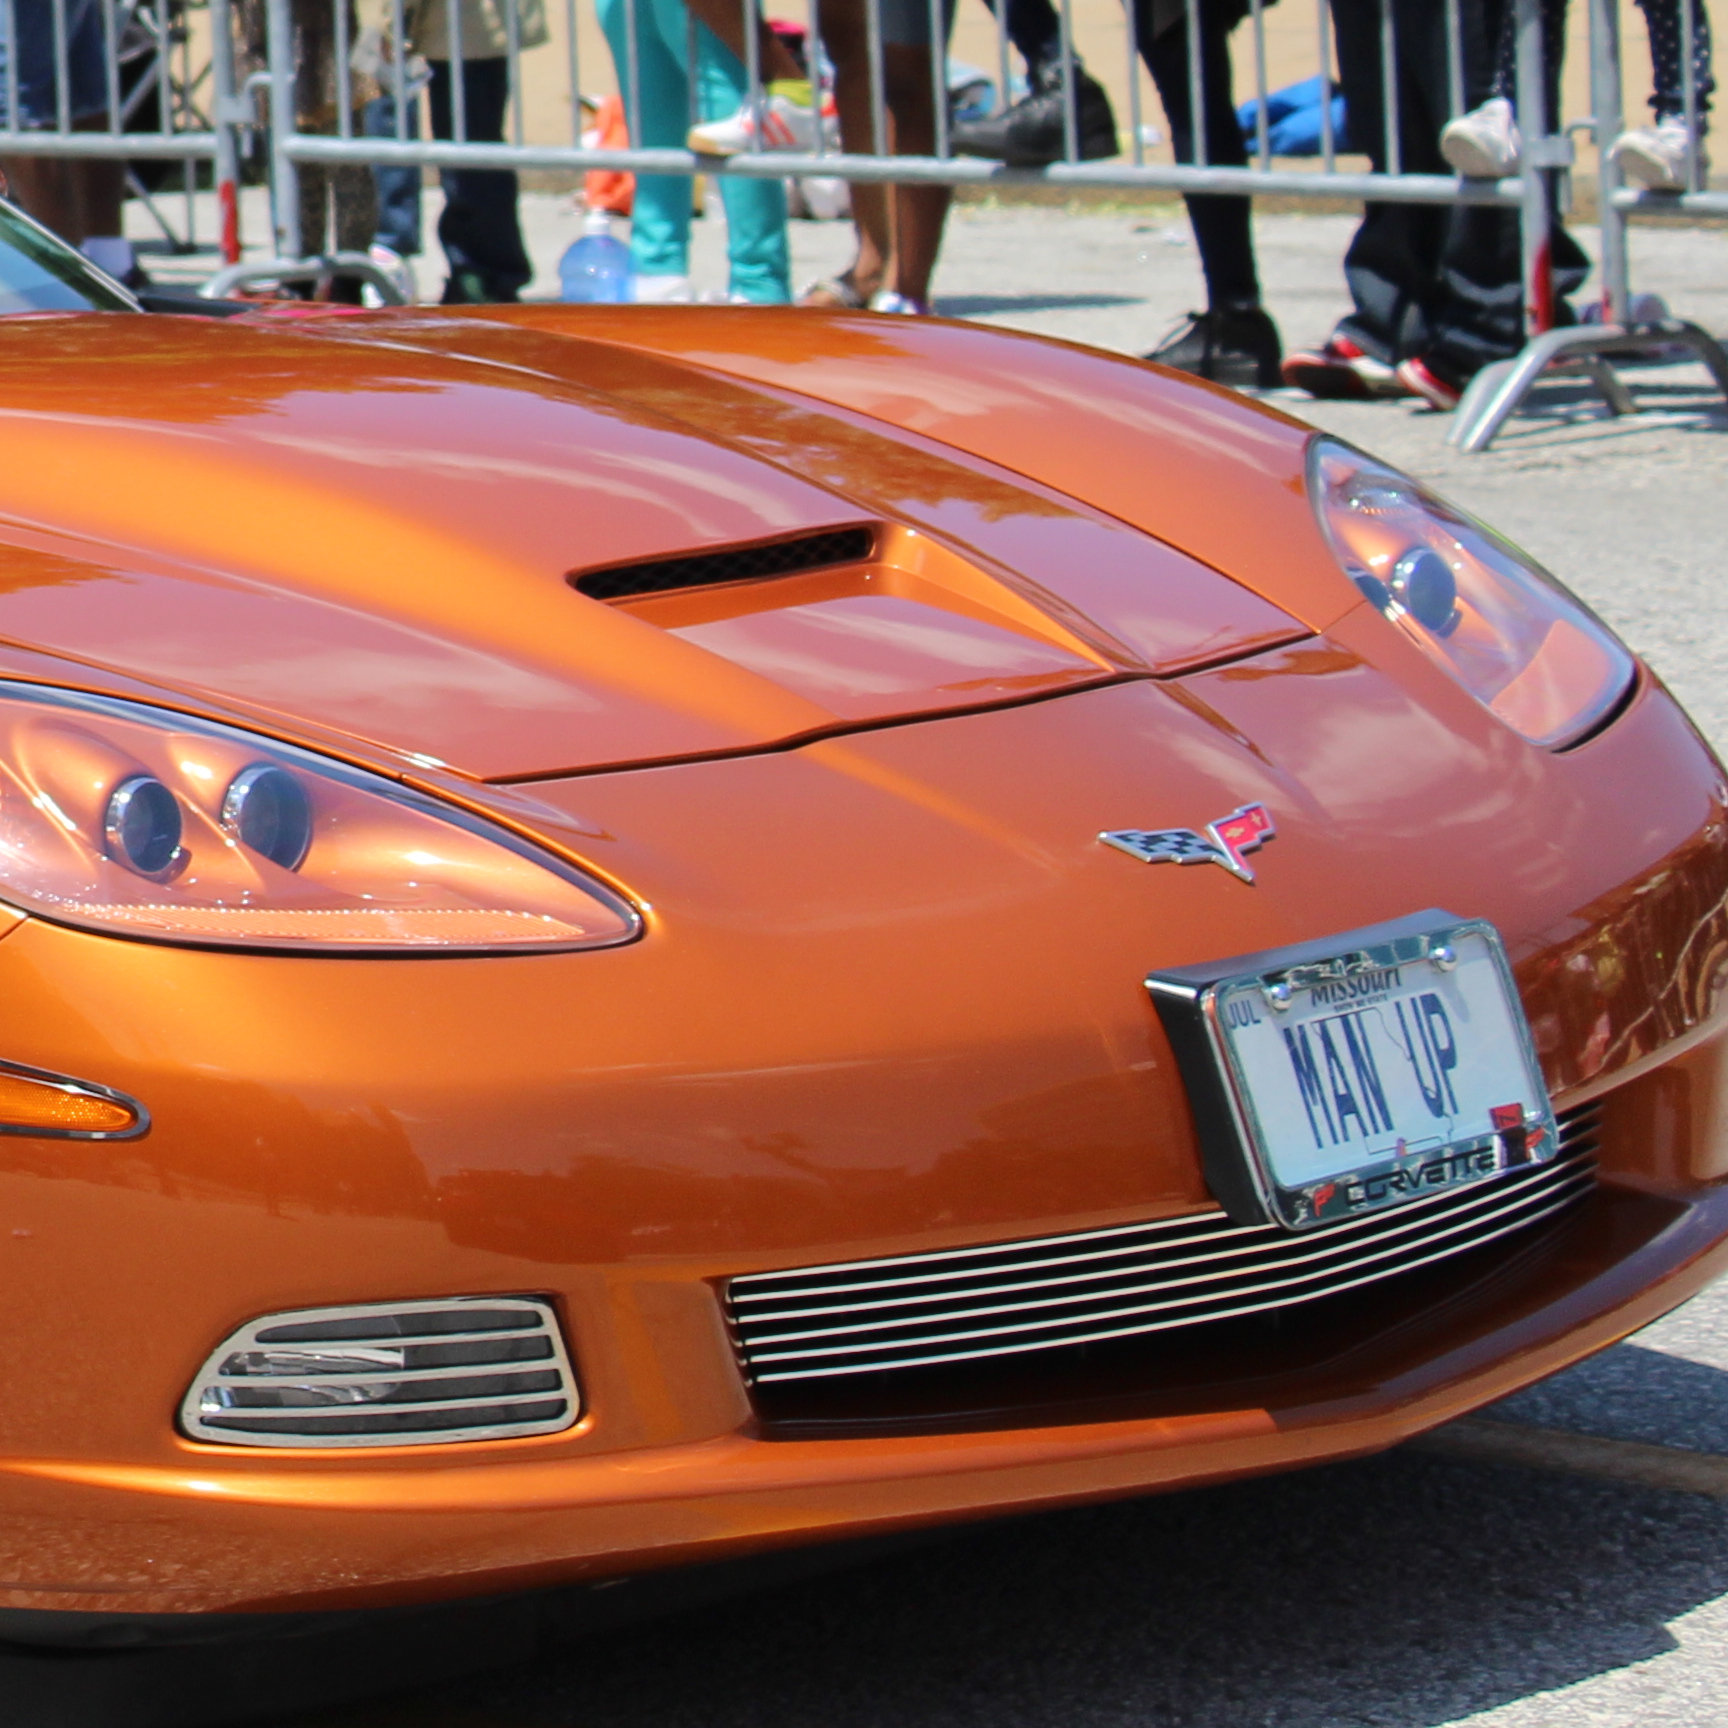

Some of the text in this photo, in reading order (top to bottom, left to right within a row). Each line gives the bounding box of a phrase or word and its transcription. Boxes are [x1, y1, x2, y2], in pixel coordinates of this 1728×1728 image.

[1228, 999, 1262, 1030] JUL
[1282, 992, 1460, 1150] MAN UP
[1345, 1145, 1495, 1207] CORVETTE
